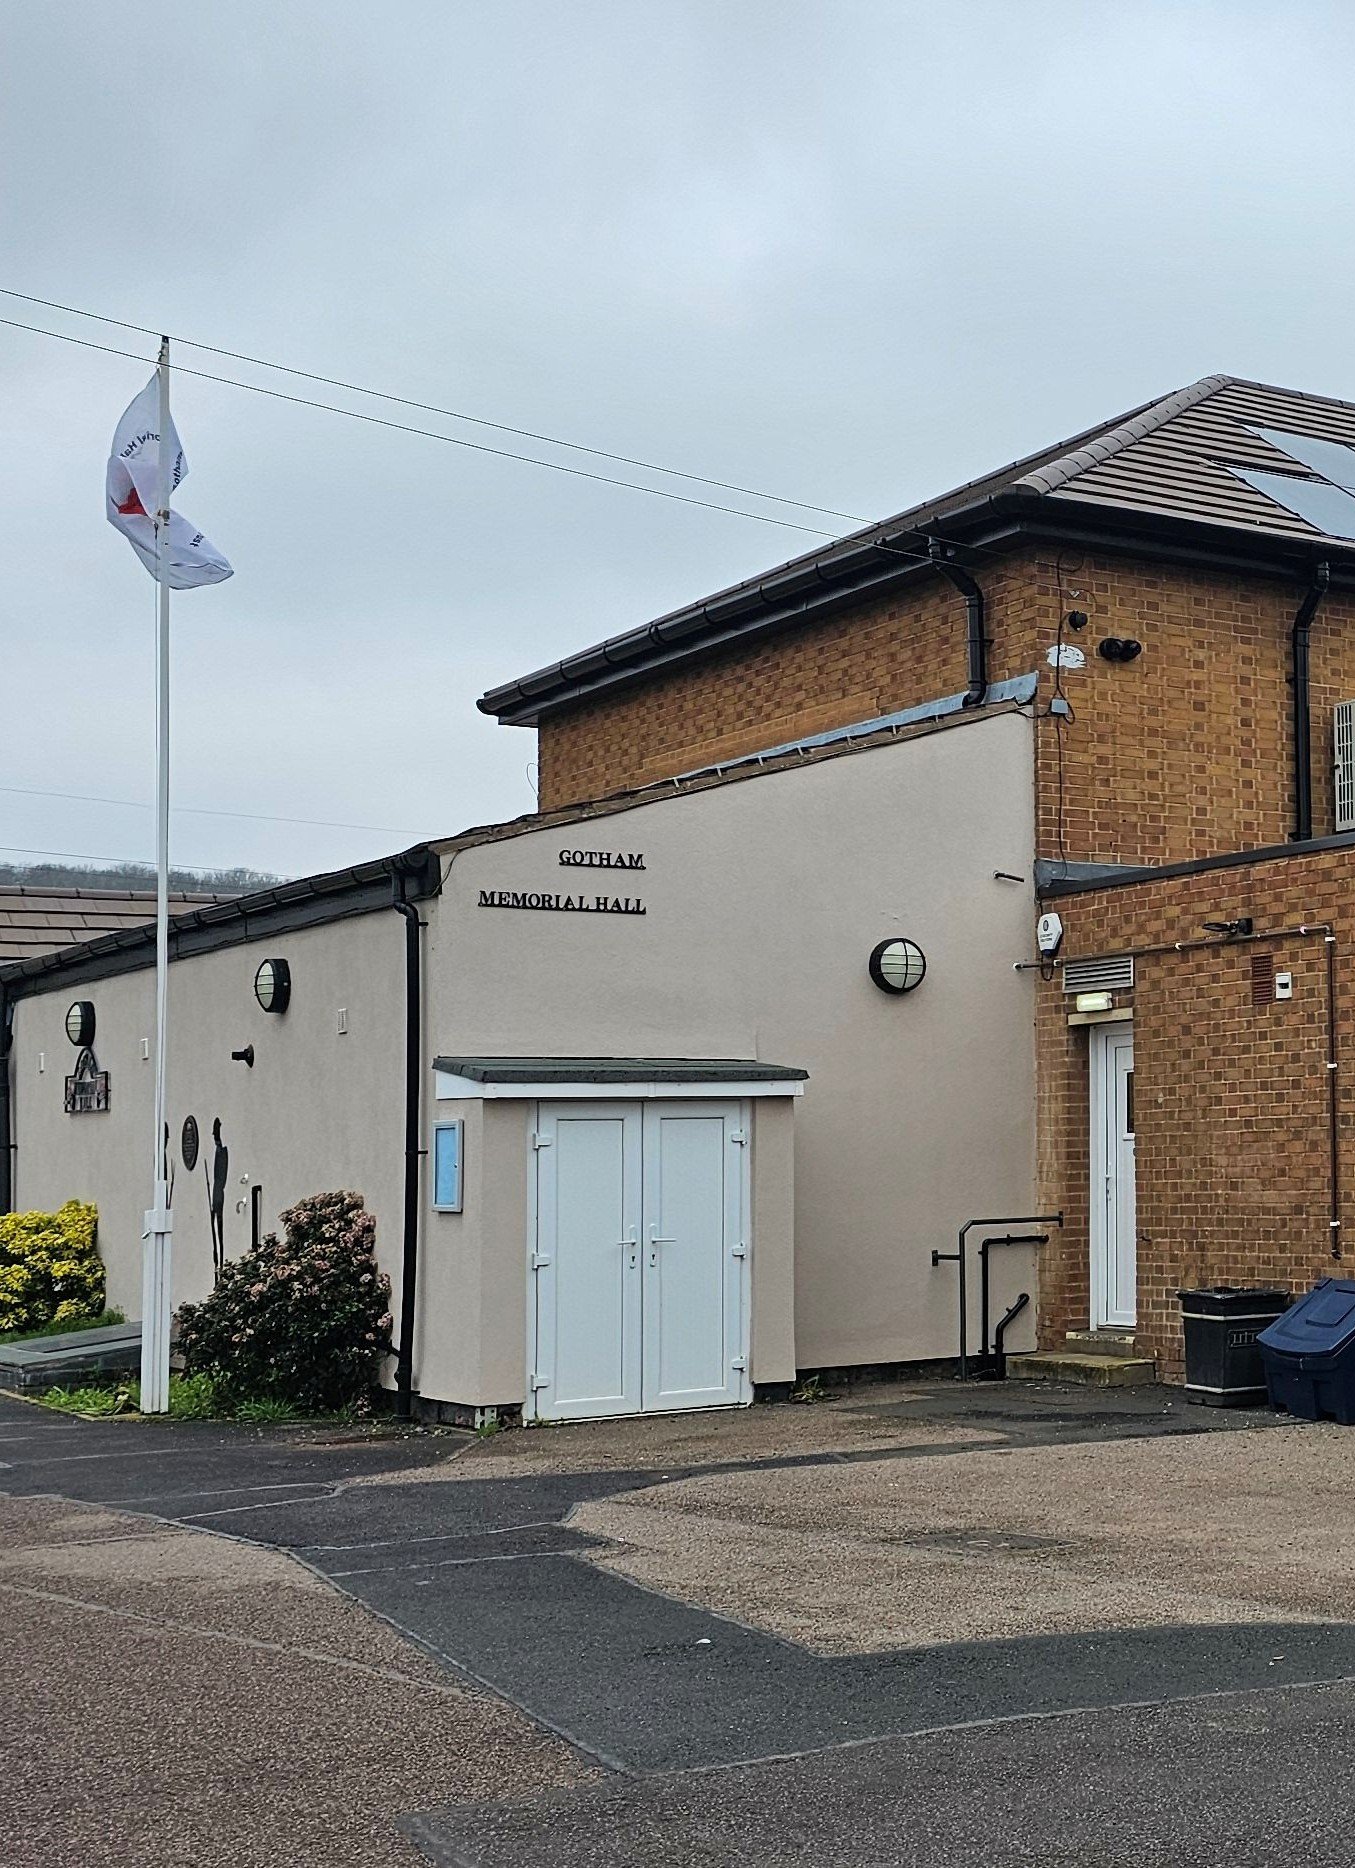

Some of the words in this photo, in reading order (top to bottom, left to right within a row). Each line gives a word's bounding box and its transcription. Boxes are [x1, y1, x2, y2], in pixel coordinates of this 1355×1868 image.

[558, 849, 646, 869] GOTHAM
[478, 890, 590, 912] MEMORIAL
[594, 896, 647, 914] HALL
